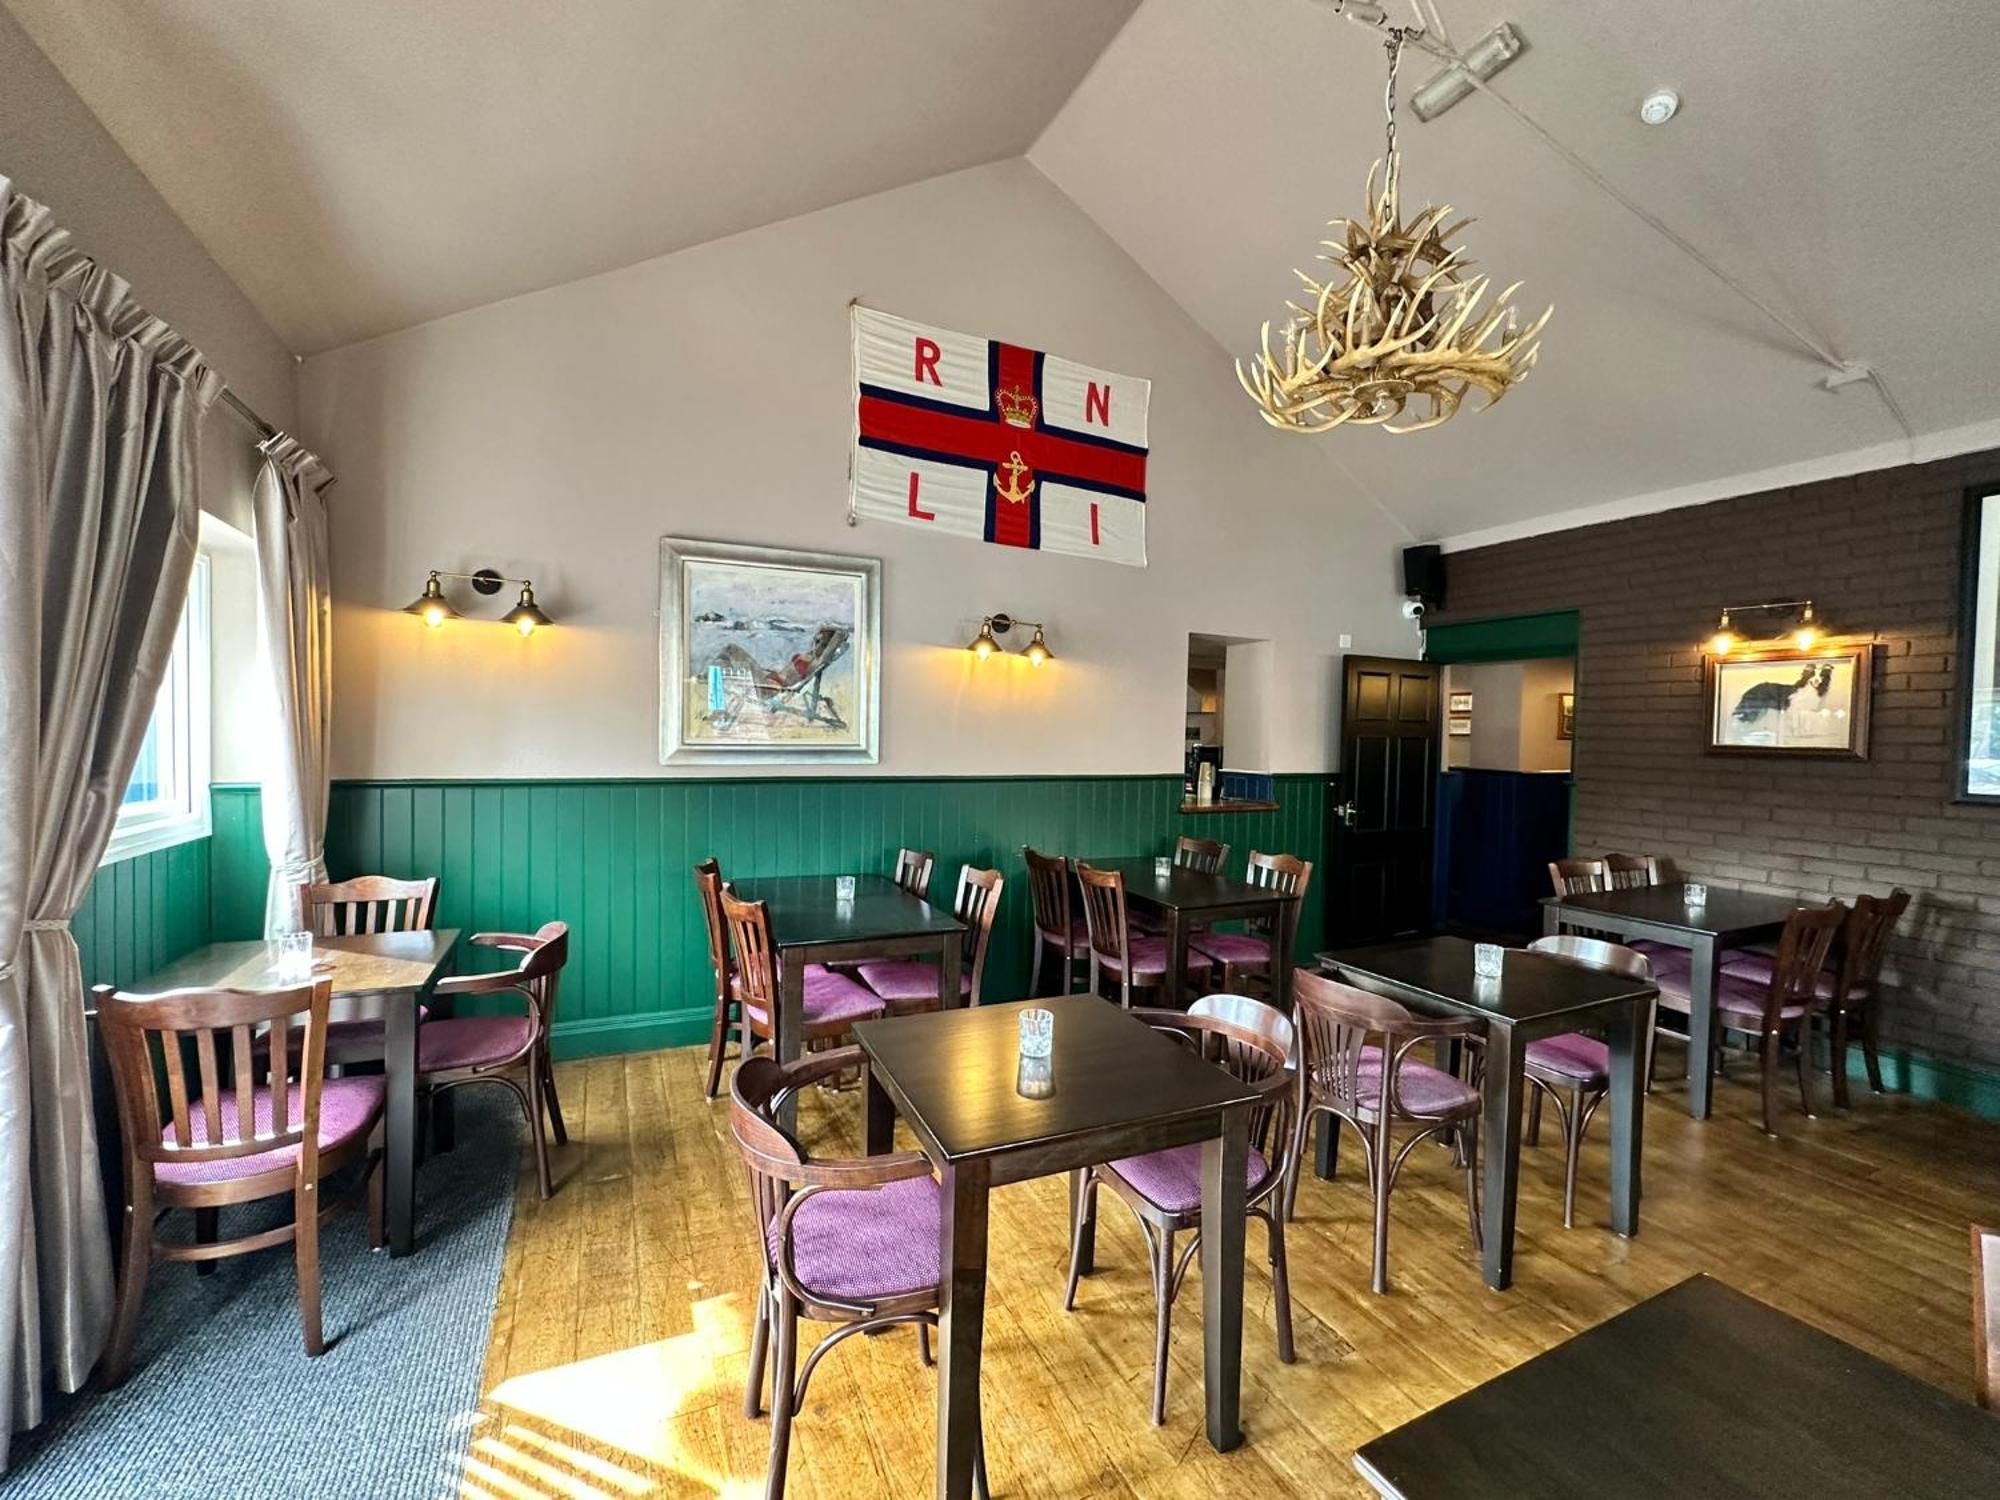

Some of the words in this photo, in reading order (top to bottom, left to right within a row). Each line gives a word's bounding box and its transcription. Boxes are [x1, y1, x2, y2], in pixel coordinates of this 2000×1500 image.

[914, 337, 942, 386] R
[1086, 382, 1110, 426] N
[908, 472, 935, 521] L
[1090, 503, 1100, 545] I
